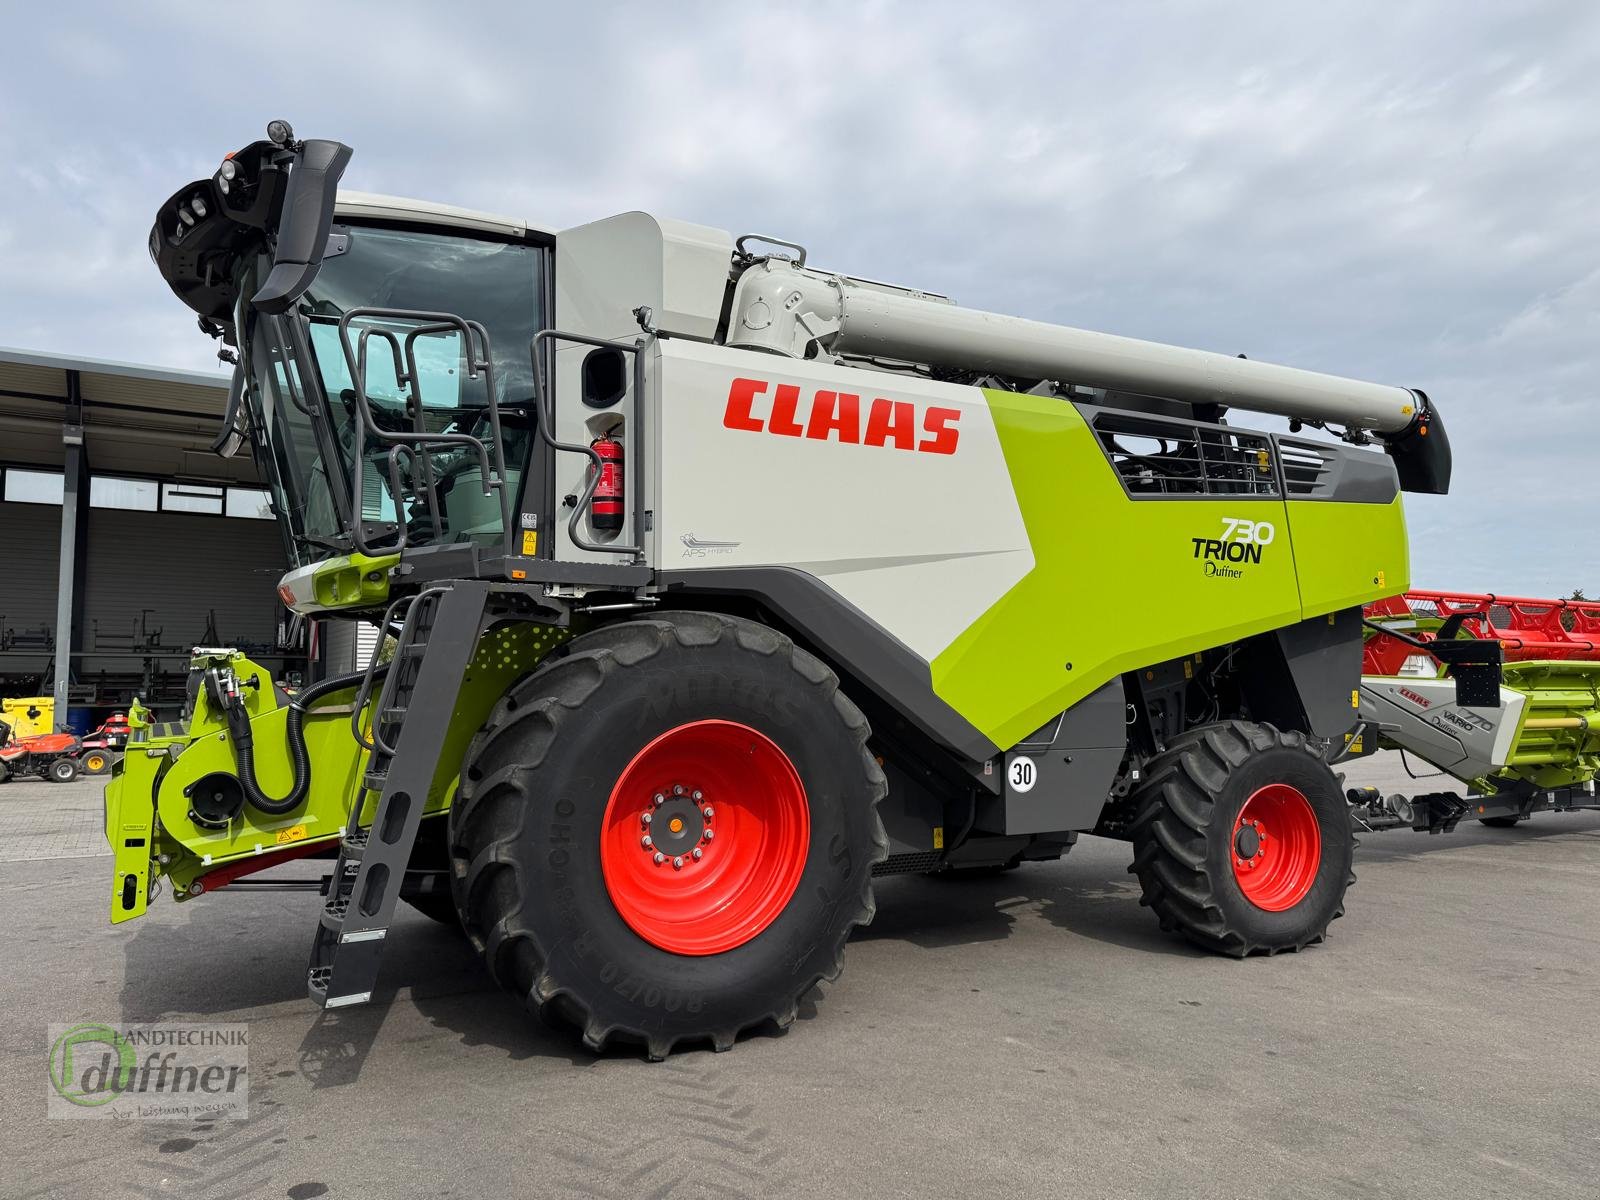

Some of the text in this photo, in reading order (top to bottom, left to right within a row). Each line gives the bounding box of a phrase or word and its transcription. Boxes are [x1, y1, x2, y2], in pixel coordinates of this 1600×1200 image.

[723, 377, 962, 455] CLAAS
[1220, 517, 1275, 545] 730
[682, 548, 706, 558] APS
[1192, 537, 1263, 564] TRION
[1204, 560, 1243, 579] Duffner
[1398, 686, 1433, 708] CLAAS
[1442, 709, 1475, 732] VARIO
[1013, 763, 1032, 785] 30
